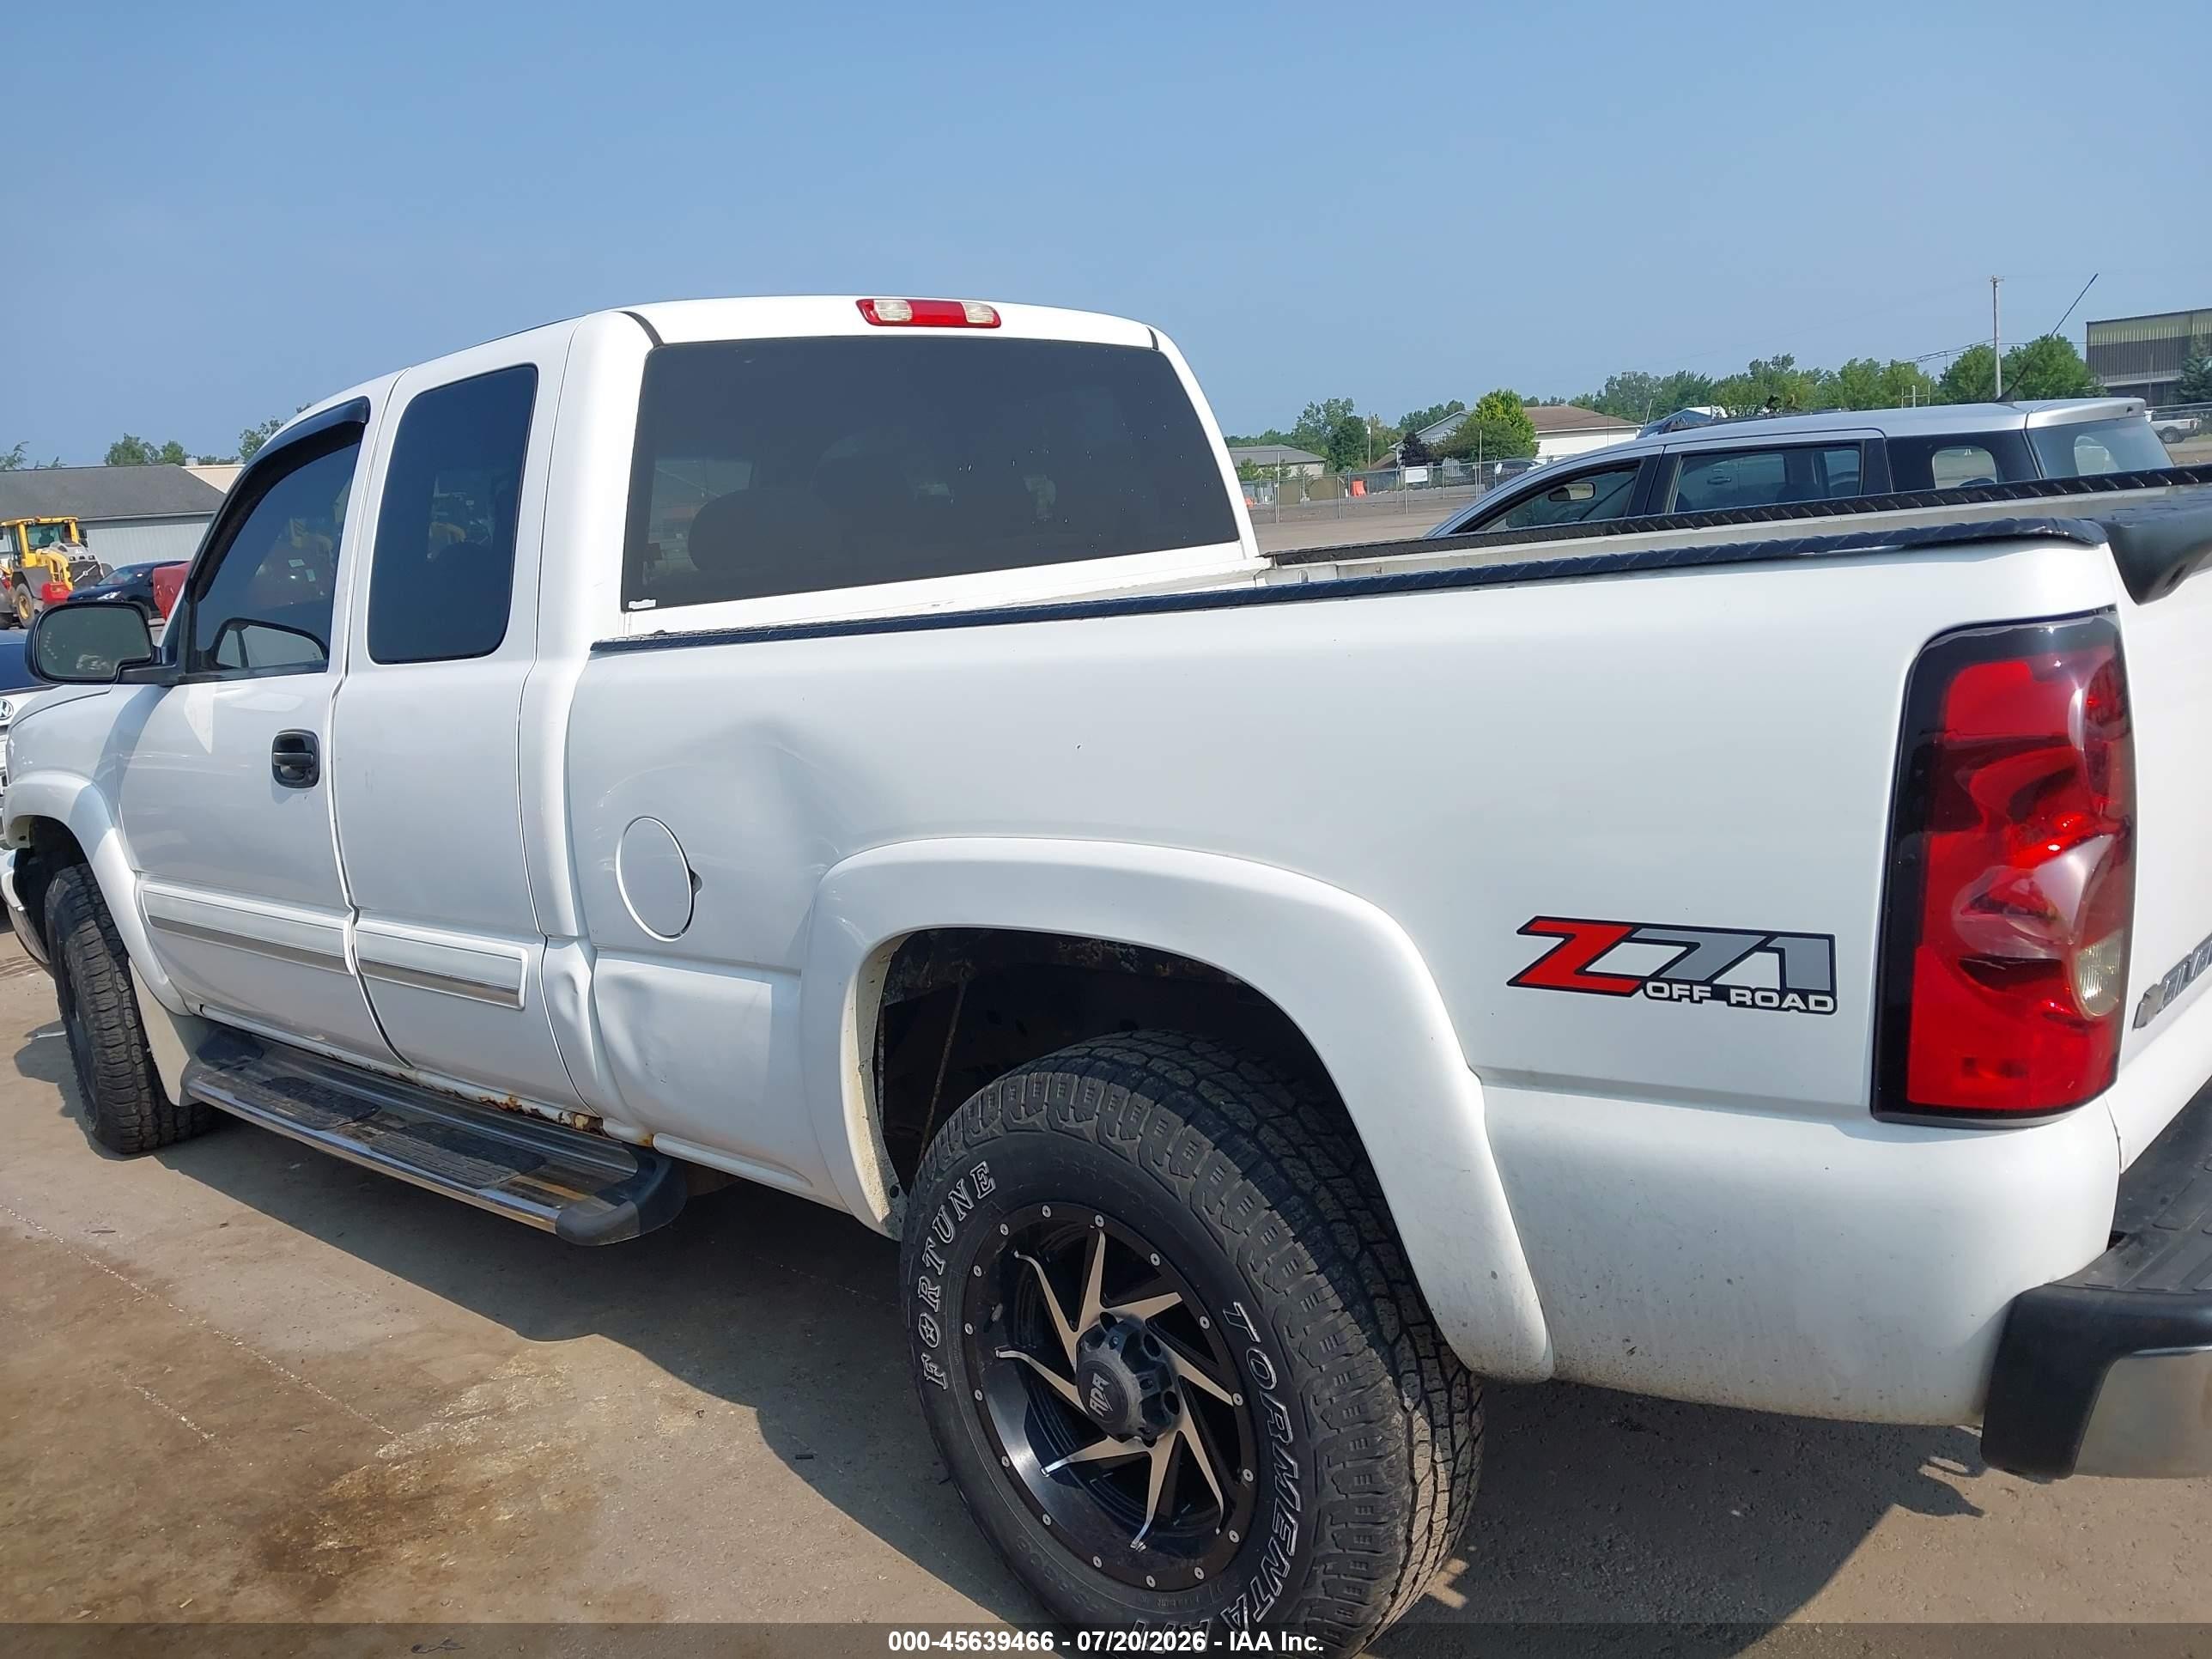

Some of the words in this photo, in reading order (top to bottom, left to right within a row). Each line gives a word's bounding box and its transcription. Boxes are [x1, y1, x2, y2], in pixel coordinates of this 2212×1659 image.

[1506, 915, 1837, 998] Z71
[1645, 981, 1712, 1002] OFF
[1729, 987, 1836, 1013] ROAD
[917, 1160, 996, 1390] FORTUNE
[1219, 1300, 1302, 1635] TORMENTA
